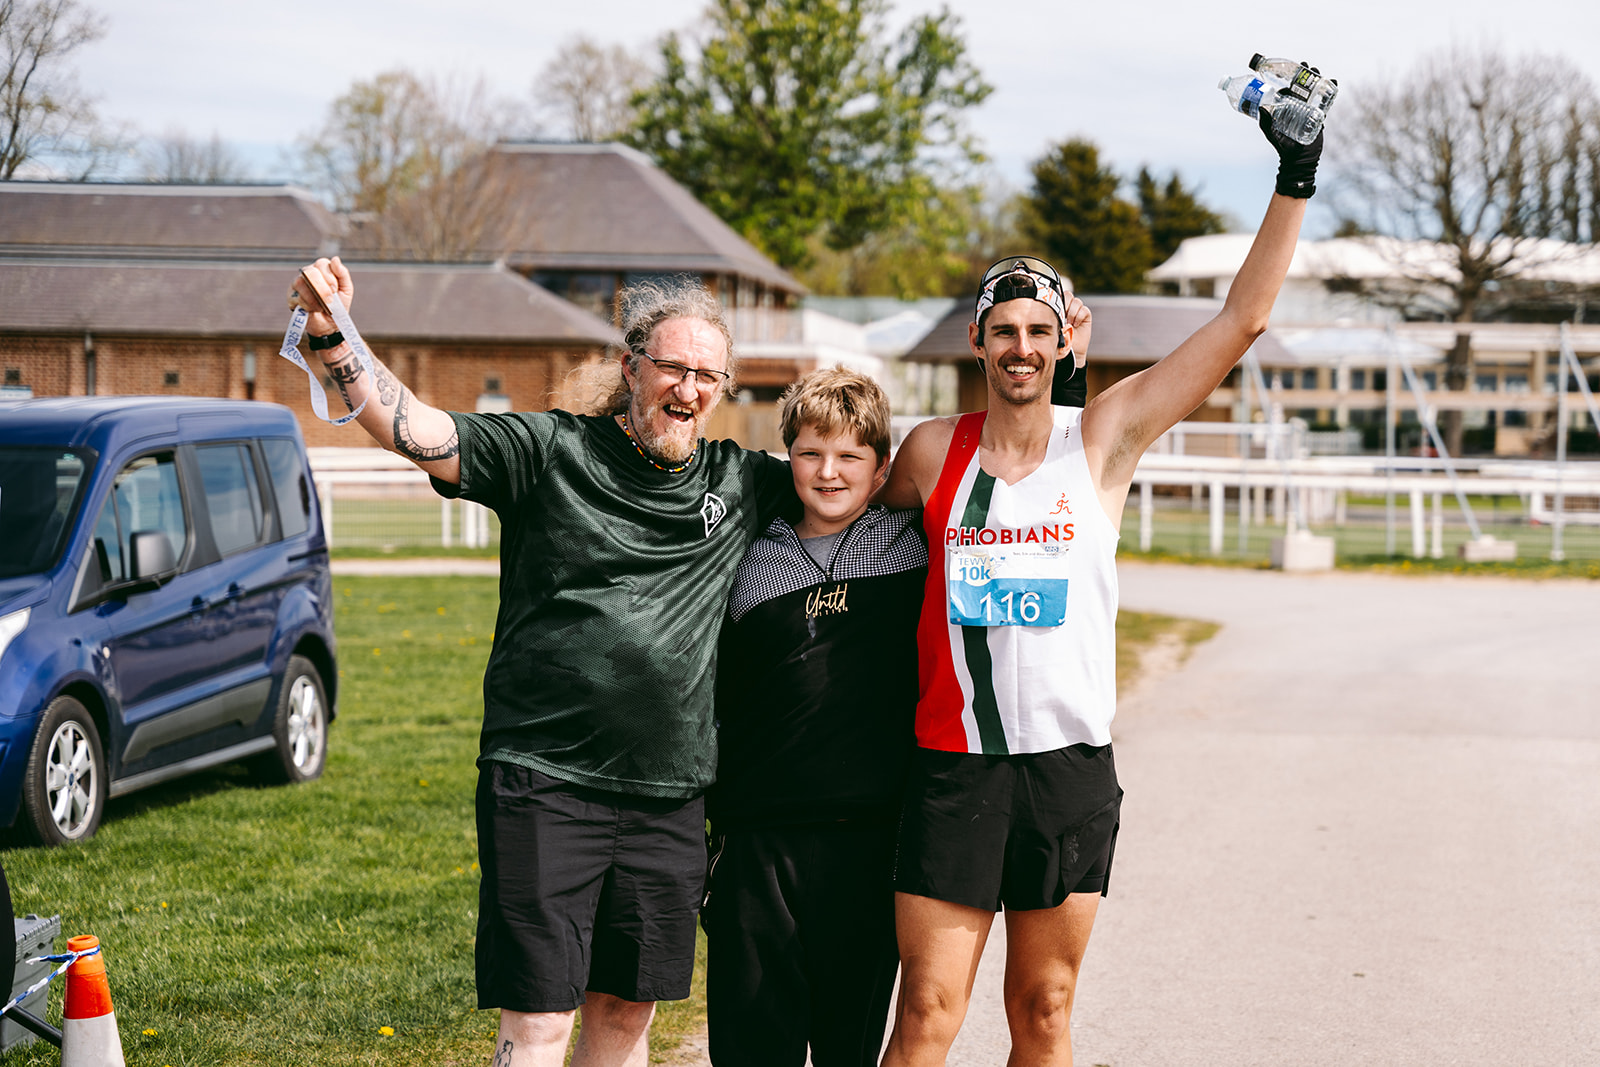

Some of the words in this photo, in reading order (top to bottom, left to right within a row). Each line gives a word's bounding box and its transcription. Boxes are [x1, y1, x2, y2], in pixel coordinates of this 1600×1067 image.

[945, 523, 1075, 546] PHOBIANS
[958, 557, 989, 566] TEWV
[958, 566, 991, 581] 10k
[979, 591, 1041, 623] 116
